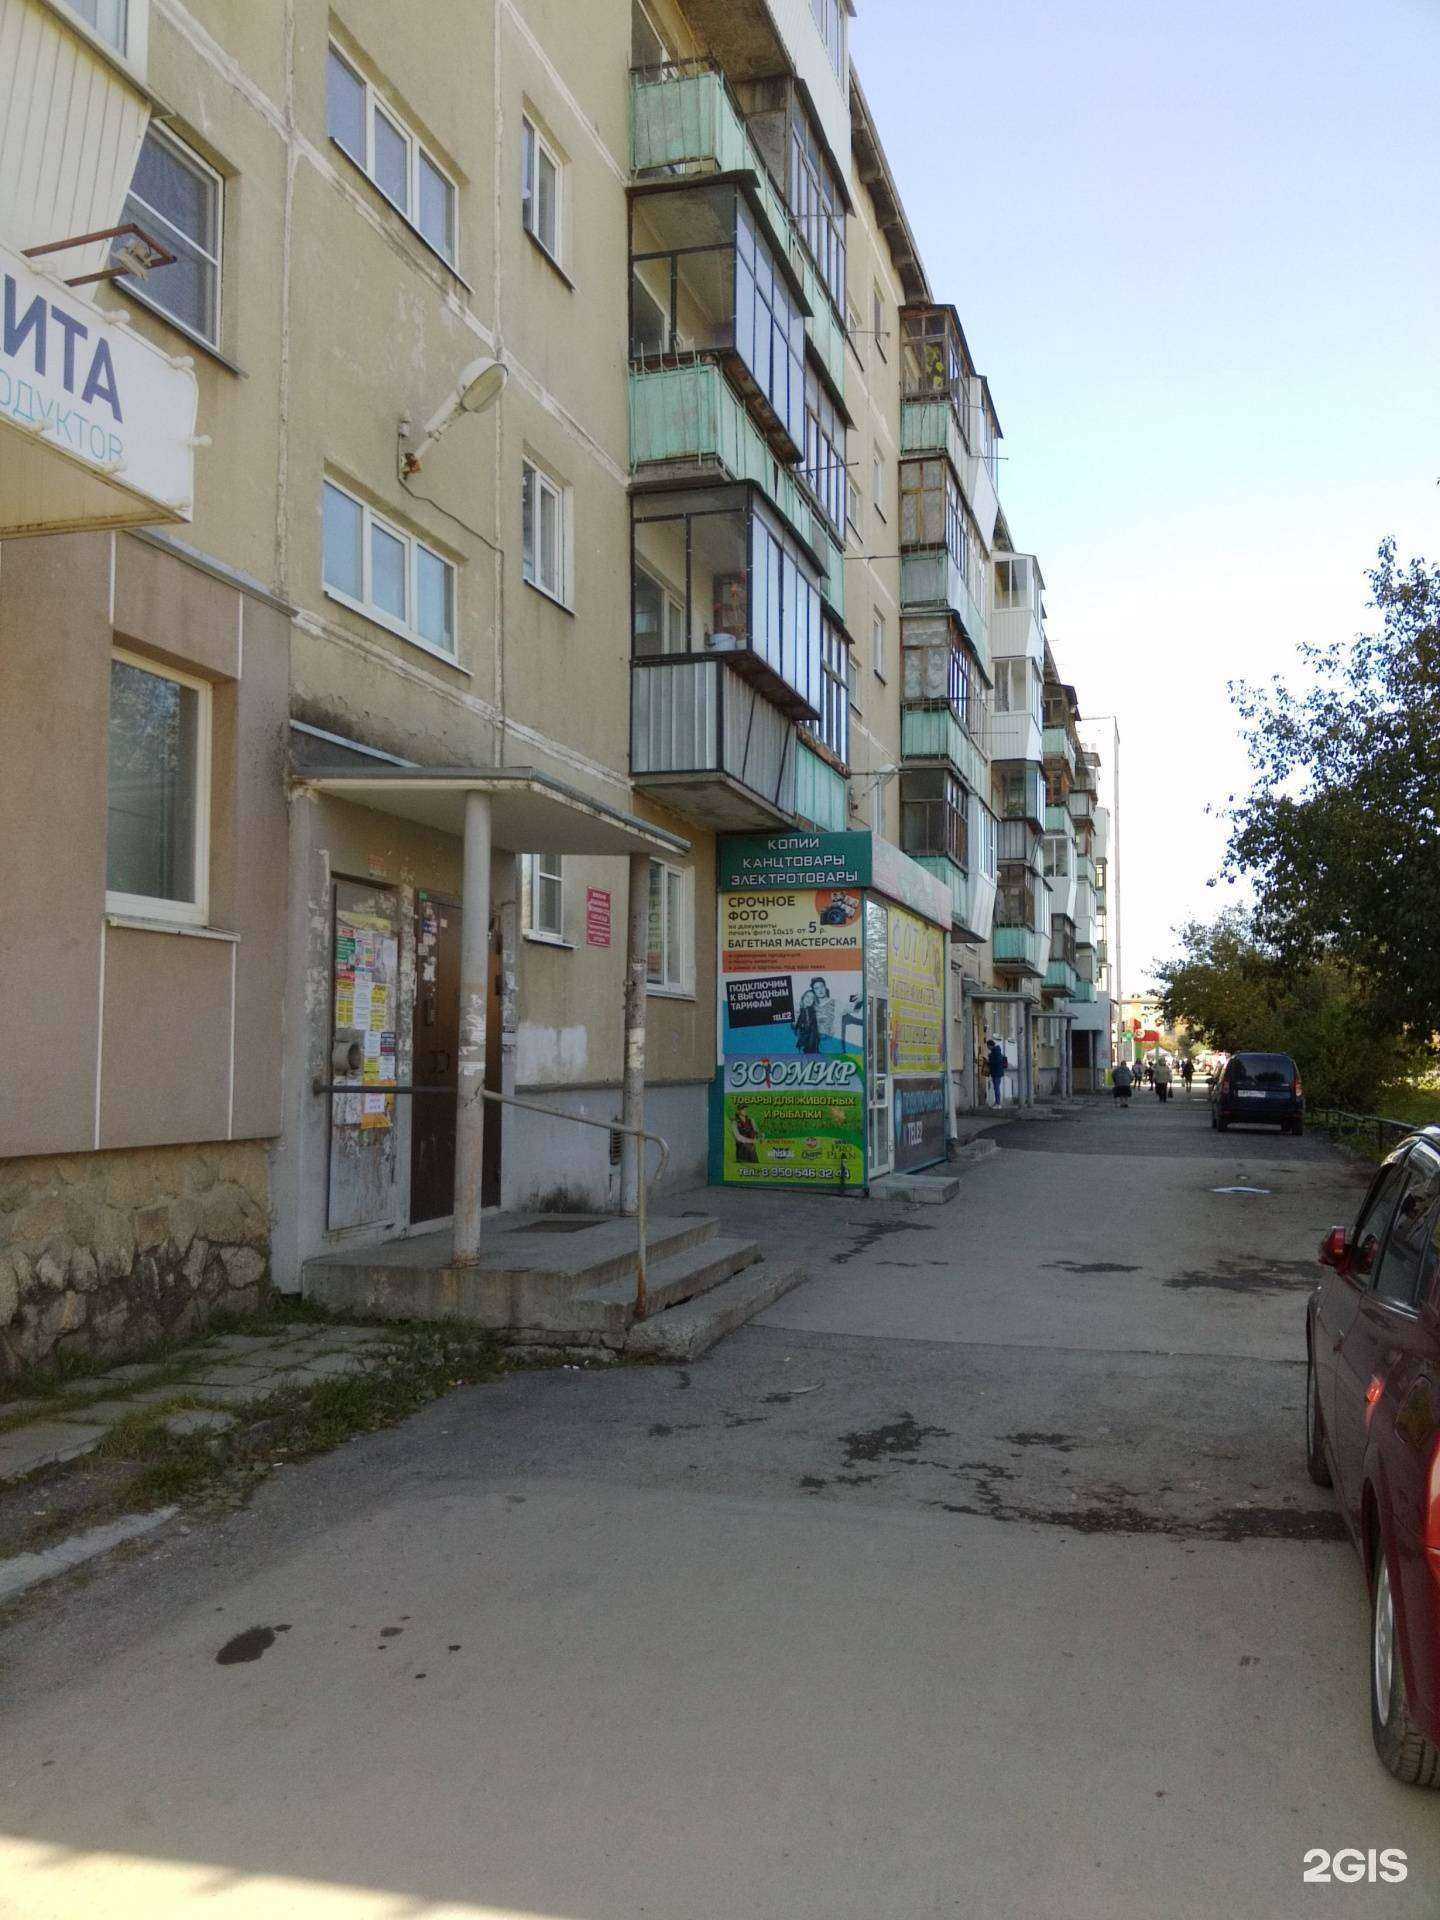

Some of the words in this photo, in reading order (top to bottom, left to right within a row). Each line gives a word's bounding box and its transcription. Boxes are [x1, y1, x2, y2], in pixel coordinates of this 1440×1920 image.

[0, 273, 123, 424] ИТА
[767, 838, 819, 849] КОПИИ
[743, 855, 845, 868] КАНЦТОВАРЫ
[731, 871, 858, 885] ЭЛЕКТРОТОВАРЫ
[728, 896, 795, 907] СРОЧНОЕ
[728, 910, 768, 921] ФОТО
[809, 921, 817, 934] 5
[728, 939, 782, 948] БАГЕТНАЯ
[785, 937, 857, 947] МАСТЕРСКАЯ
[729, 979, 787, 992] ПОДКЛЮЧИМ
[738, 988, 789, 1000] ВЫГОДНЫМ
[731, 1000, 772, 1010] ТАРИФАМ
[772, 1011, 792, 1021] TELE2
[731, 1060, 857, 1088] ЗООМИР
[733, 1096, 771, 1105] ТОВАРЫ
[774, 1096, 794, 1105] ДЛЯ
[796, 1096, 855, 1105] ЖИВОТНЫХ
[773, 1110, 822, 1119] РЫБАЛКИ
[762, 1167, 769, 1177] 8
[819, 1168, 832, 1178] 32
